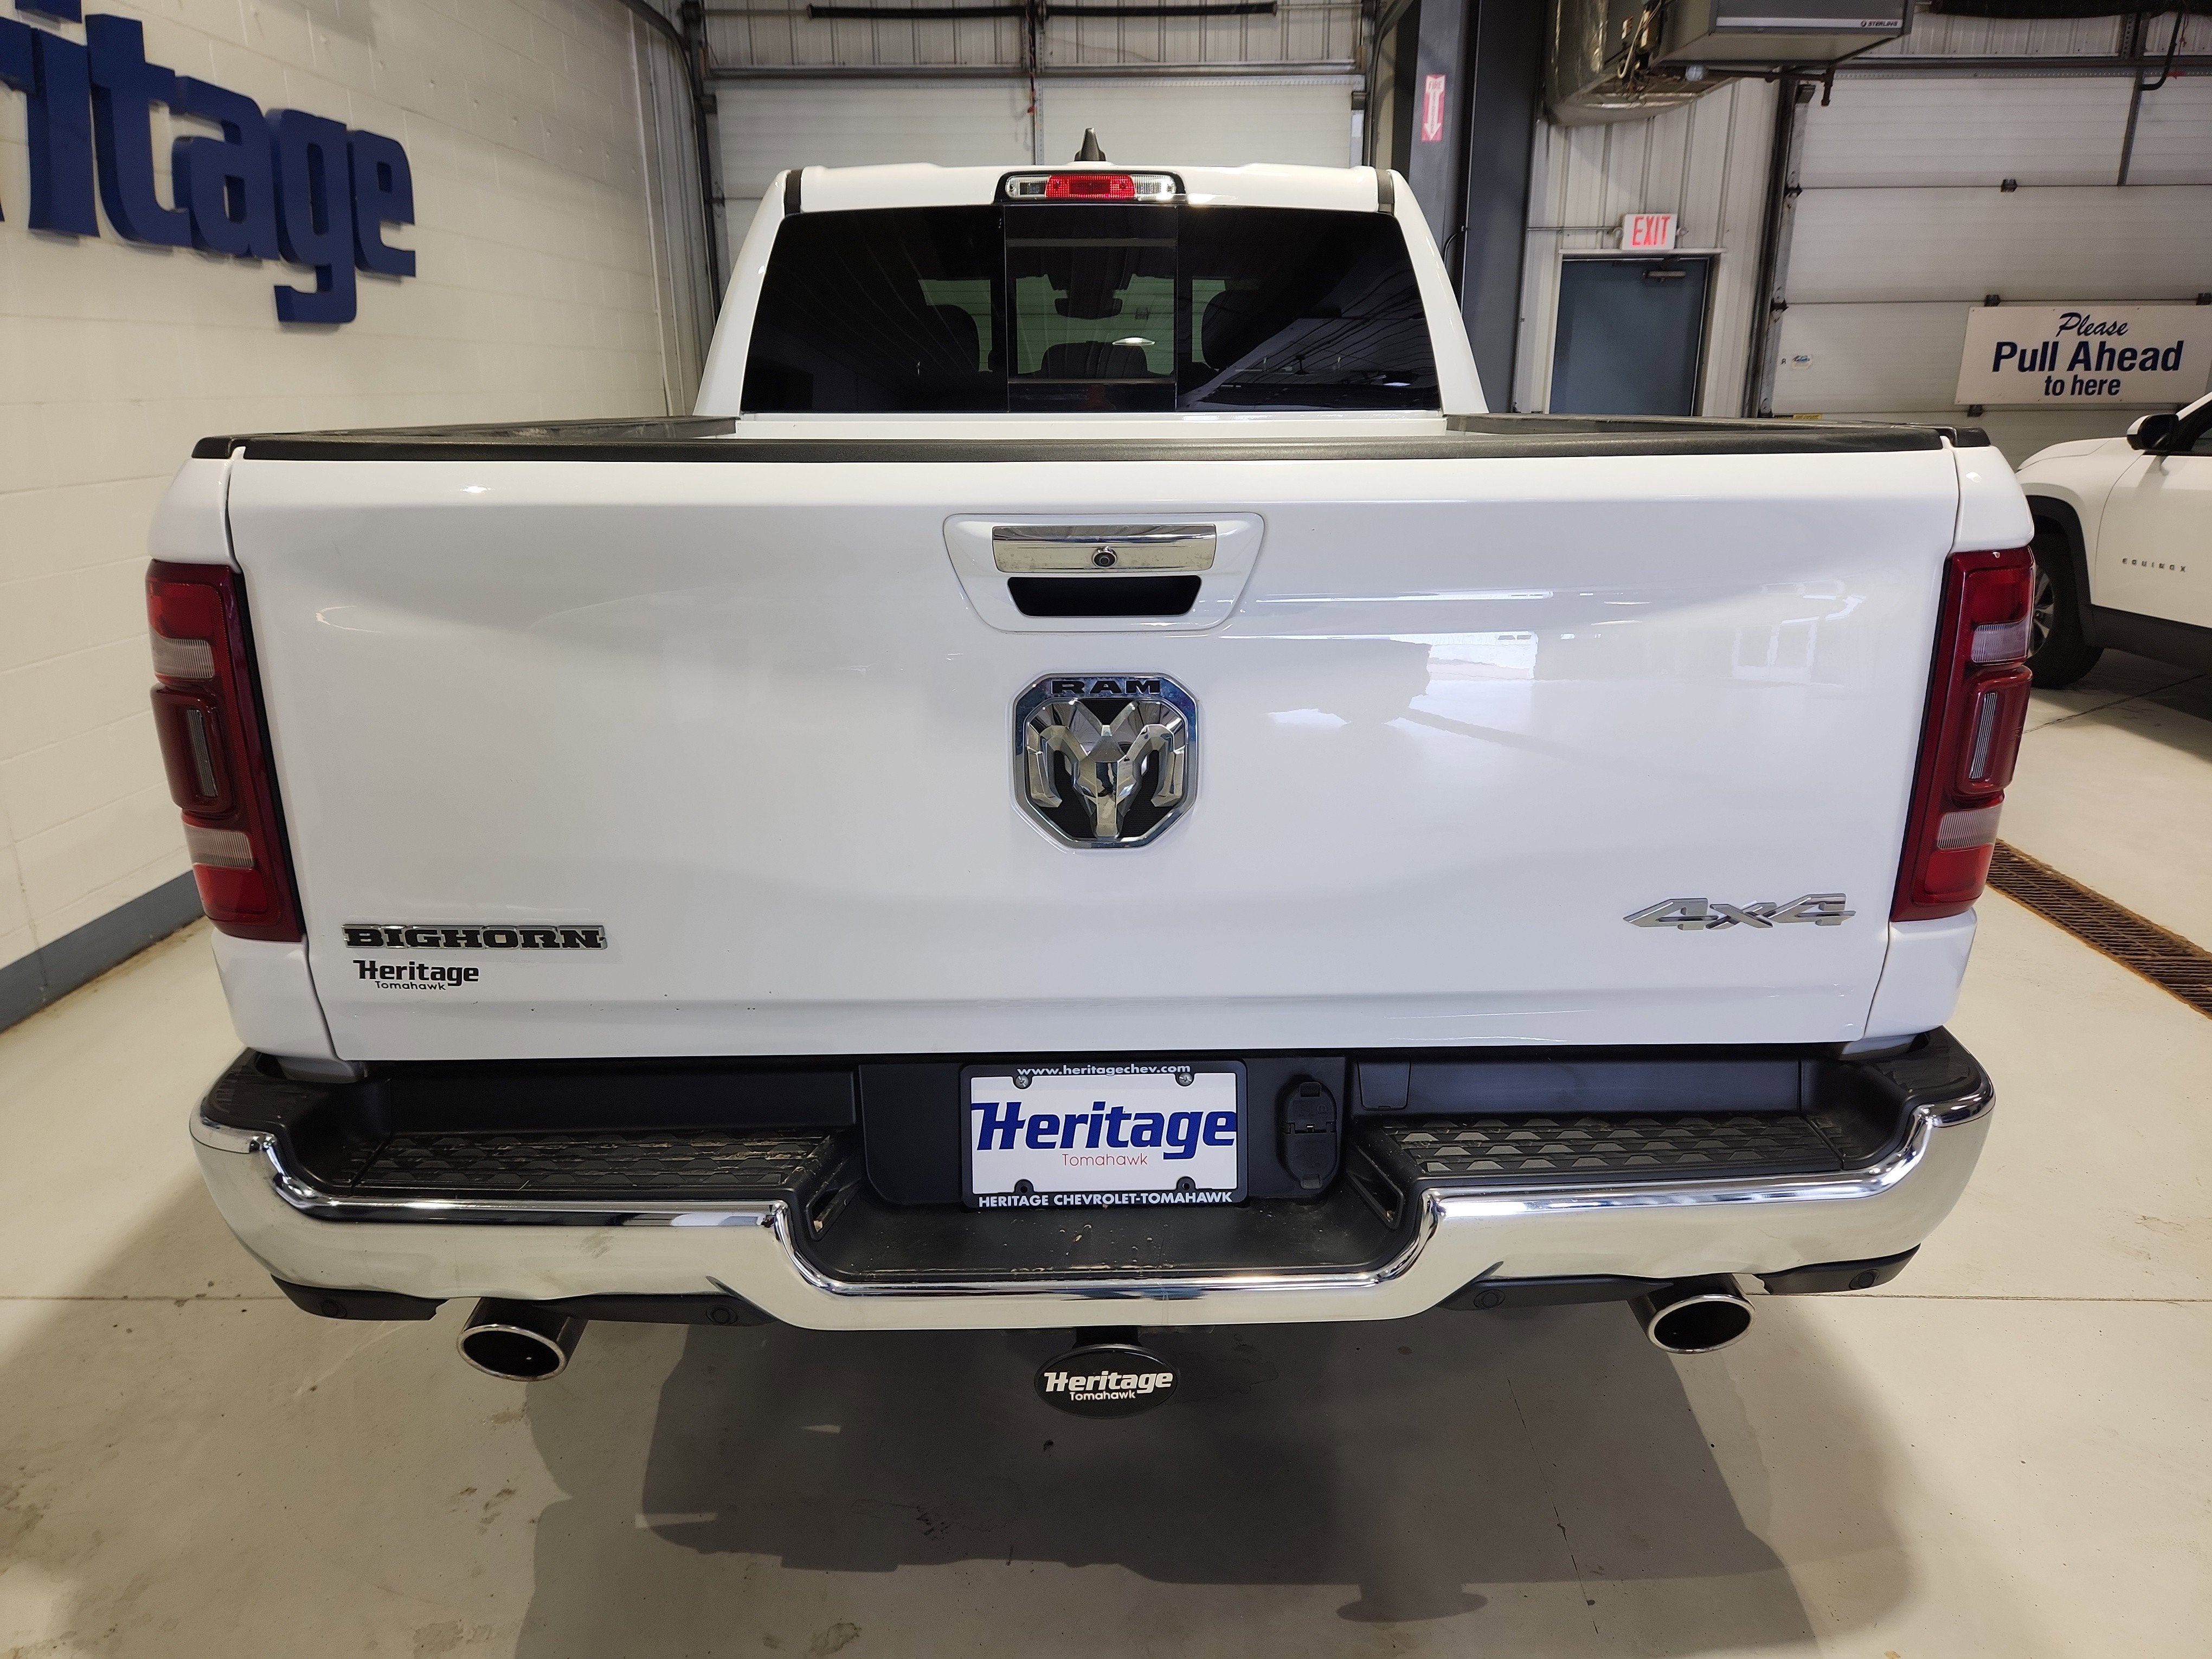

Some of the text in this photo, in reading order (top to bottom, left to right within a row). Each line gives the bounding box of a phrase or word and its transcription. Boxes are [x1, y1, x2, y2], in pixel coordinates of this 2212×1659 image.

[1428, 80, 1442, 89] FIRE
[1631, 216, 1671, 246] EXIT
[2055, 312, 2129, 337] Please
[1992, 340, 2184, 372] Pull Ahead
[2044, 375, 2121, 396] to here
[2122, 558, 2186, 572] EQUINOX
[1051, 680, 1160, 695] RAM
[342, 924, 608, 950] BIGHORN
[353, 960, 479, 986] Heritage
[375, 980, 447, 991] Tomahawk
[1017, 1064, 1191, 1076] www.heritagechev.com
[971, 1101, 1237, 1160] Heritage
[1062, 1153, 1148, 1166] Tomahawk
[979, 1192, 1233, 1207] HERITAGE CHEVROLET-TOMAHAWK
[1044, 1371, 1173, 1394] Heritage
[1069, 1390, 1136, 1401] Tomahawk
